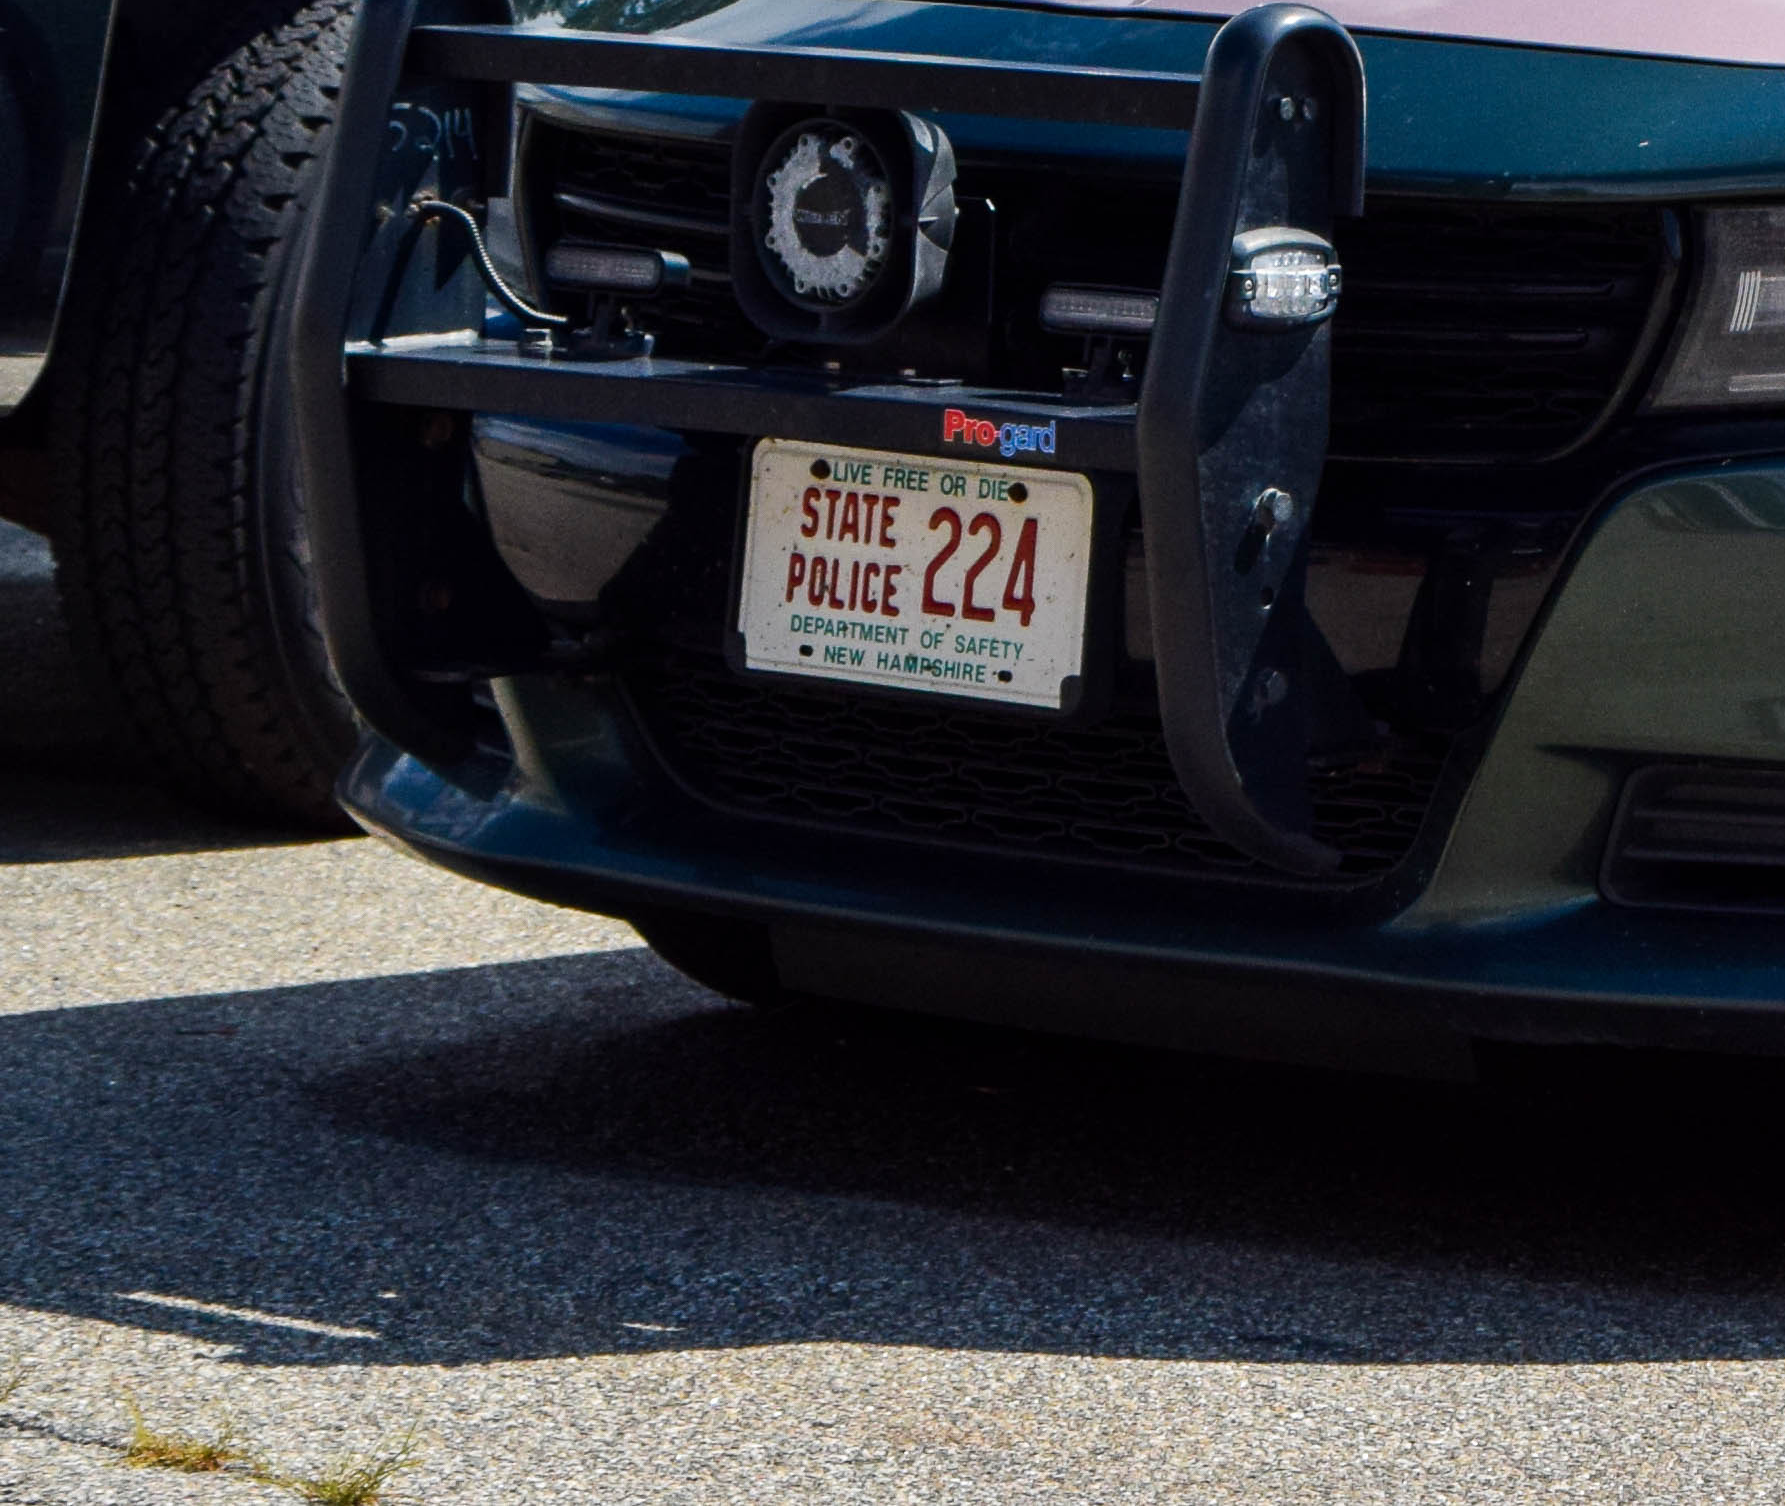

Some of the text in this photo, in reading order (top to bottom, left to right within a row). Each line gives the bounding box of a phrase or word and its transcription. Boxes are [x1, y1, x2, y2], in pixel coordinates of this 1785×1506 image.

[943, 408, 1057, 457] Pro-gard
[833, 462, 1009, 502] LIVE FREE OR DIE
[800, 487, 901, 548] STATE
[785, 552, 902, 617] POLICE
[922, 506, 1038, 627] 224
[790, 614, 1025, 660] DEPARTMENT OF SAFETY
[824, 645, 987, 683] NEW HAMPSHIRE
